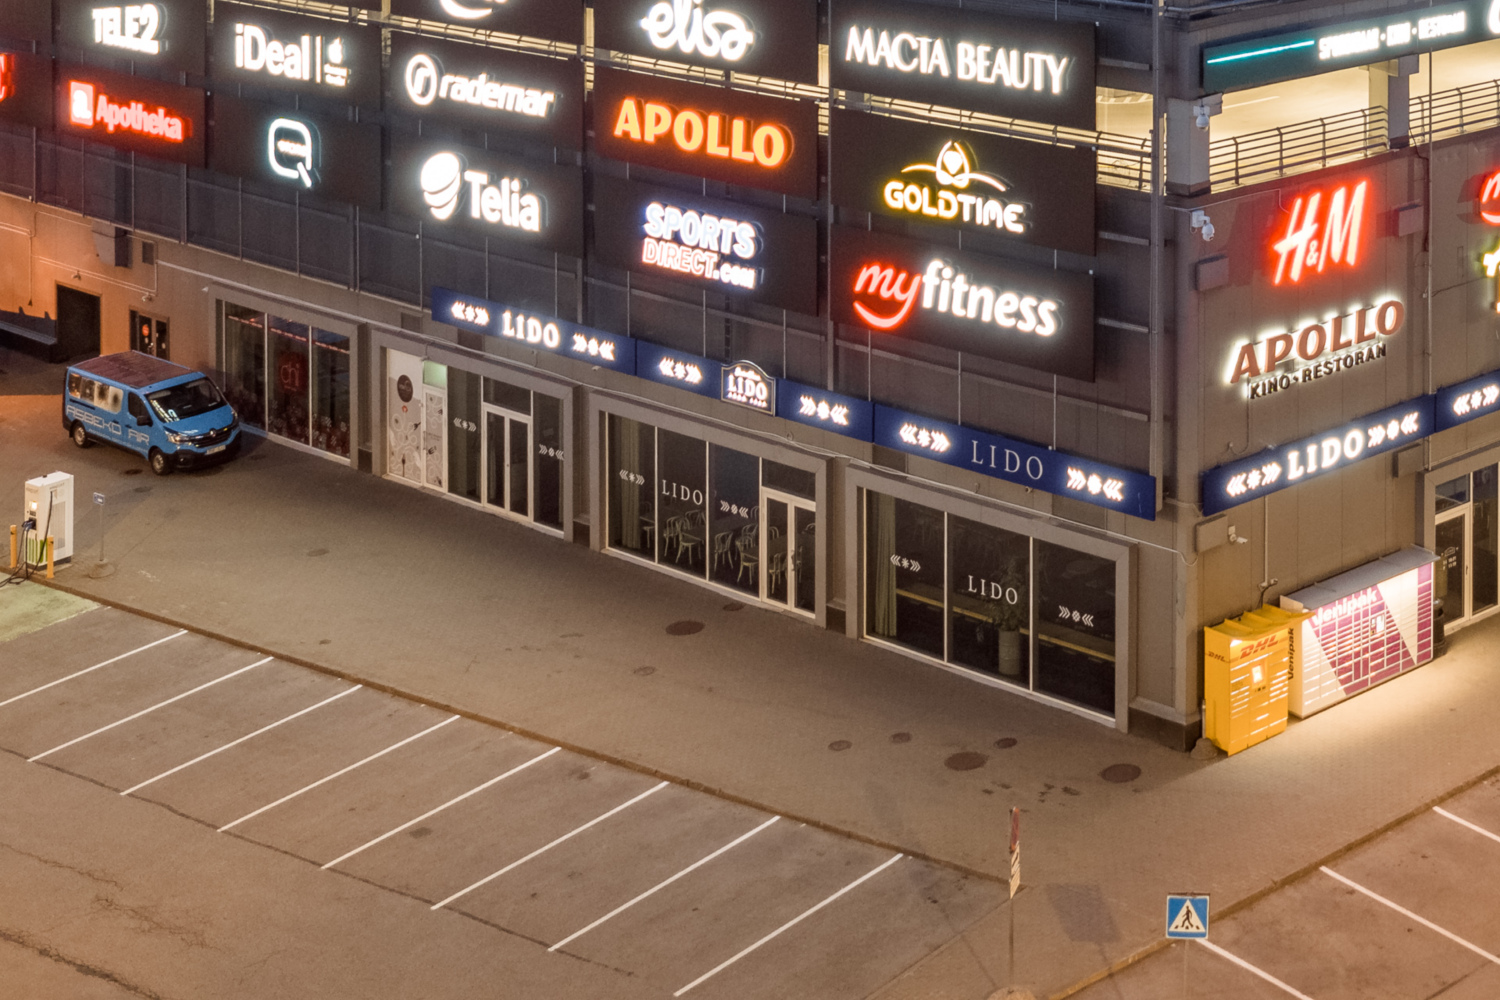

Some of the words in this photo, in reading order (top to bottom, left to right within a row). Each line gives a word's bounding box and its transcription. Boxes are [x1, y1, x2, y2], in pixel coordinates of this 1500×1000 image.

[92, 3, 159, 55] TELE2
[235, 22, 310, 81] iDeal
[845, 25, 950, 77] MACTA
[957, 42, 1068, 94] BEAUTY
[96, 94, 183, 140] Apotheka
[438, 72, 556, 118] rademar
[614, 98, 785, 167] APOLLO
[464, 170, 541, 232] Telia
[884, 181, 1024, 234] GOLDTIME
[643, 201, 757, 259] SPORTS
[1273, 180, 1369, 286] H&M
[502, 310, 561, 349] LIDO
[1230, 300, 1405, 384] APOLLO
[727, 373, 768, 401] LIDO
[1250, 374, 1291, 399] KINO
[1302, 344, 1387, 383] RESTORAN
[128, 428, 150, 446] AIR
[971, 440, 1044, 481] LIDO
[1286, 429, 1364, 481] LIDO
[661, 479, 703, 506] LIDO
[968, 575, 1018, 605] LIDO
[1312, 587, 1378, 627] Venipak
[1207, 651, 1227, 663] DHL
[1240, 634, 1279, 660] DHL
[1287, 627, 1295, 681] Venipak
